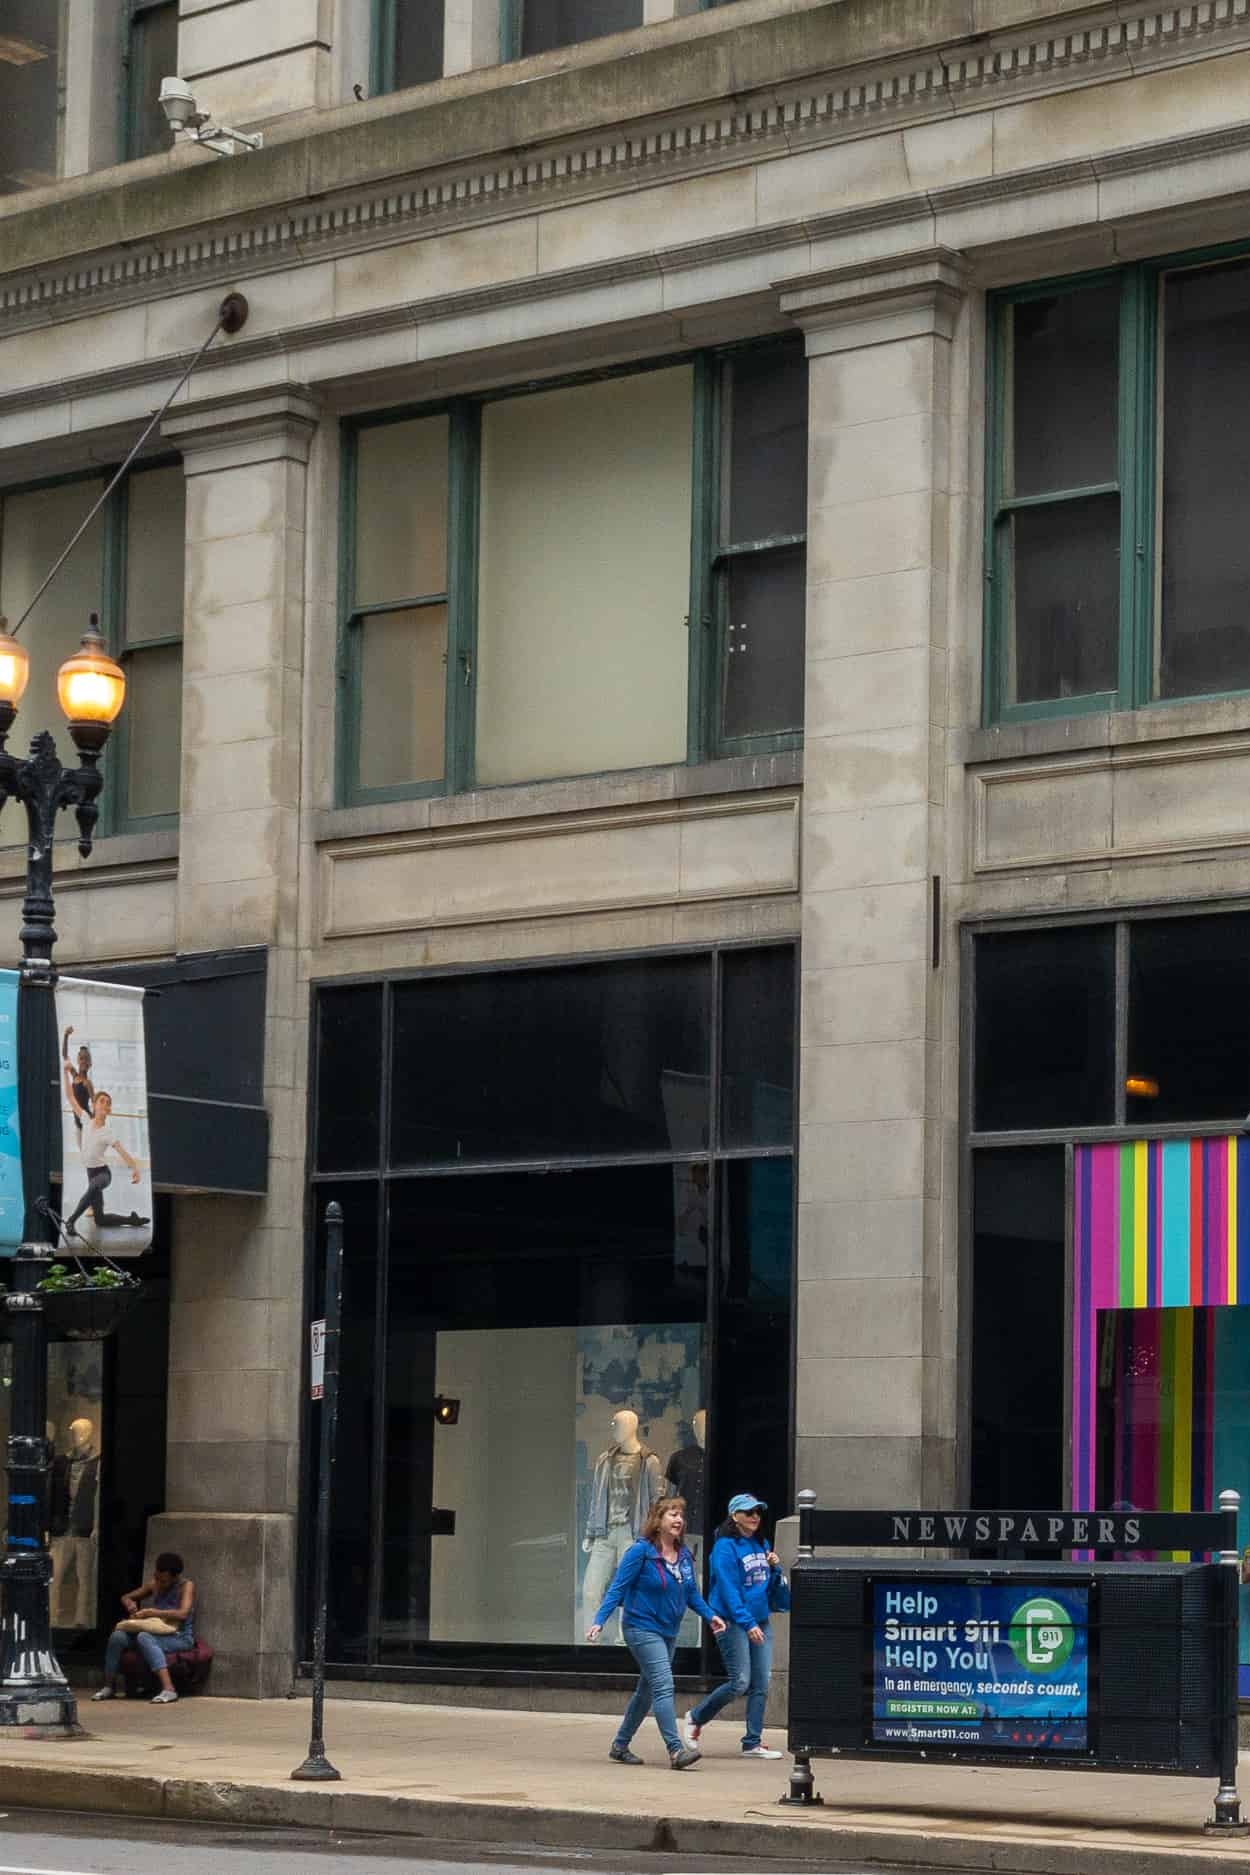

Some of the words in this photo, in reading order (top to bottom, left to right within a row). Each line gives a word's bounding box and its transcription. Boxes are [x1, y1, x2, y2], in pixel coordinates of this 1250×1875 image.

[892, 1516, 1141, 1543] NEWSPAPERS
[885, 1591, 938, 1618] Help
[884, 1618, 957, 1642] Smart
[964, 1619, 1000, 1642] 911
[1042, 1631, 1060, 1642] 911
[885, 1645, 938, 1673] Help
[945, 1647, 988, 1670] You
[885, 1677, 895, 1691] In
[897, 1679, 911, 1691] an
[914, 1682, 975, 1696] emergency,
[976, 1681, 1034, 1696] seconds
[1037, 1684, 1081, 1697] count.
[890, 1703, 934, 1714] REGISTER
[936, 1705, 960, 1715] NOW
[962, 1706, 977, 1715] AT:
[885, 1727, 980, 1741] www.Smart911.com
